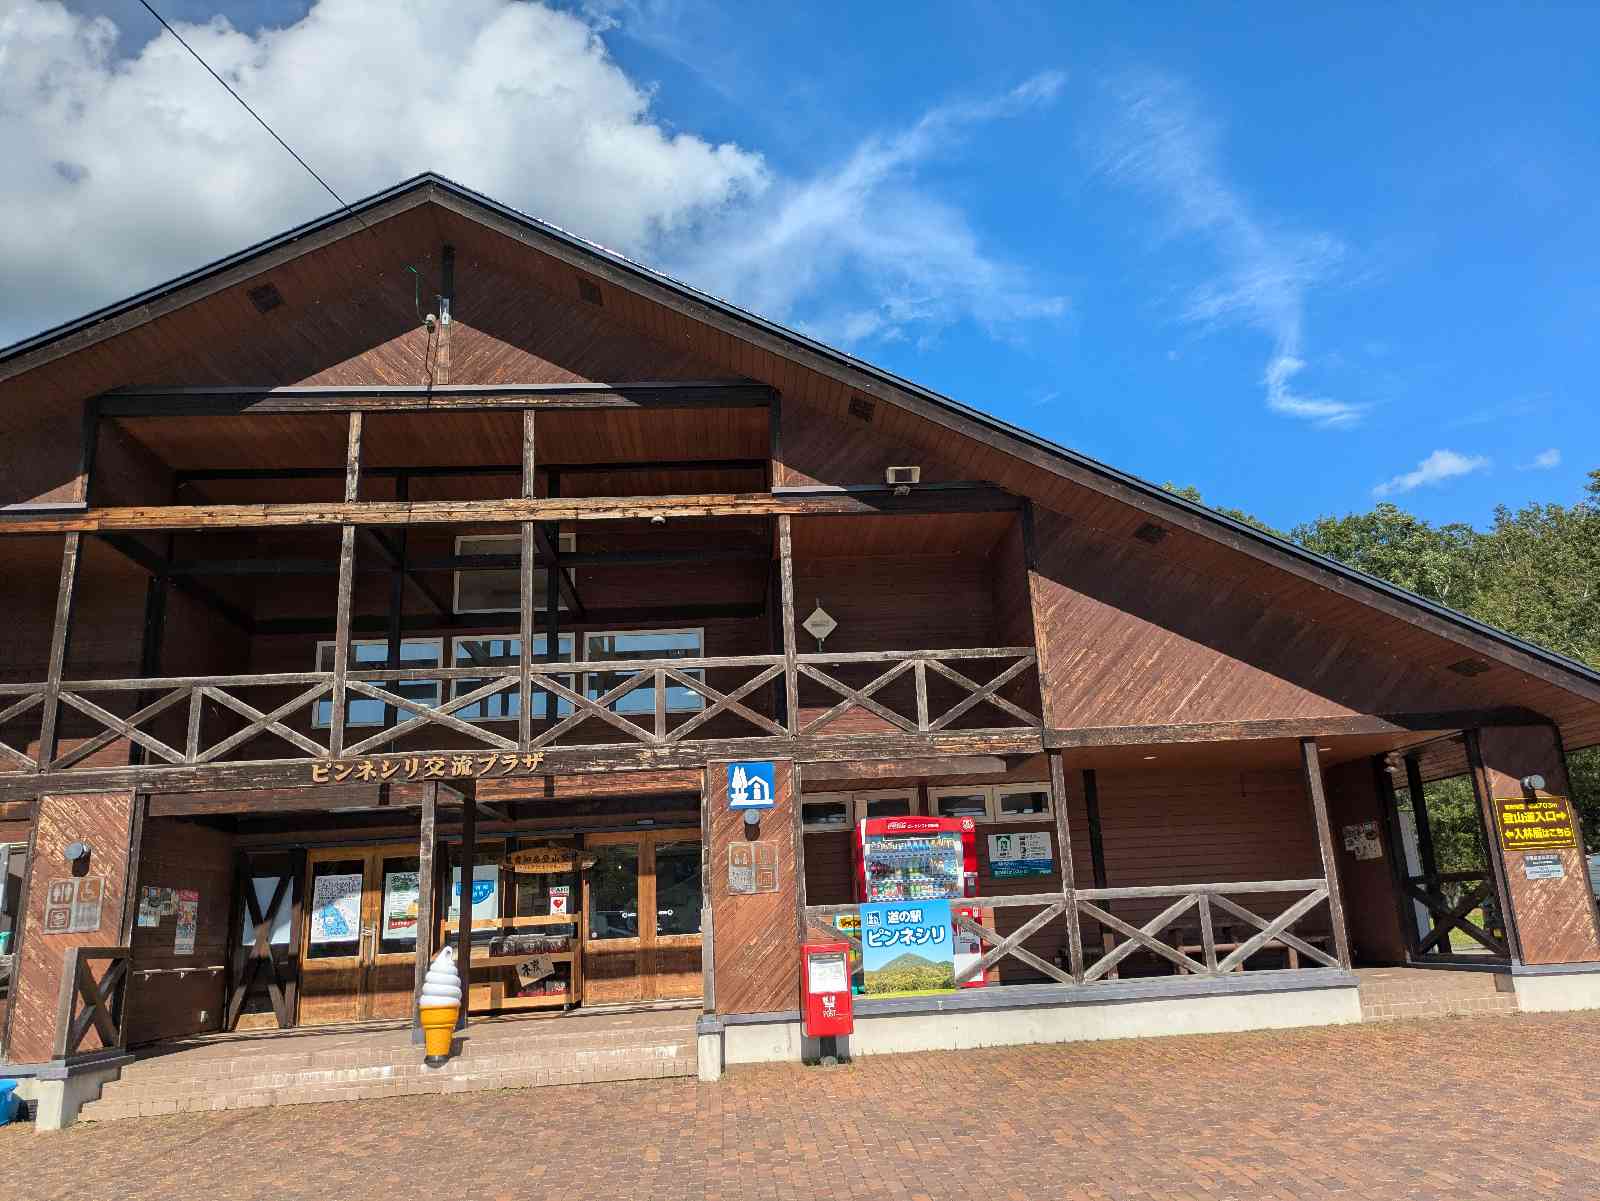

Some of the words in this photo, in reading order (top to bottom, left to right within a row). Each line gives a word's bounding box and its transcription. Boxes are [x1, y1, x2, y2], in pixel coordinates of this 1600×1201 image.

[311, 752, 544, 783] ピンネシリ交流プラザ
[887, 909, 922, 925] 道の駅
[867, 926, 946, 947] ピンネシリ
